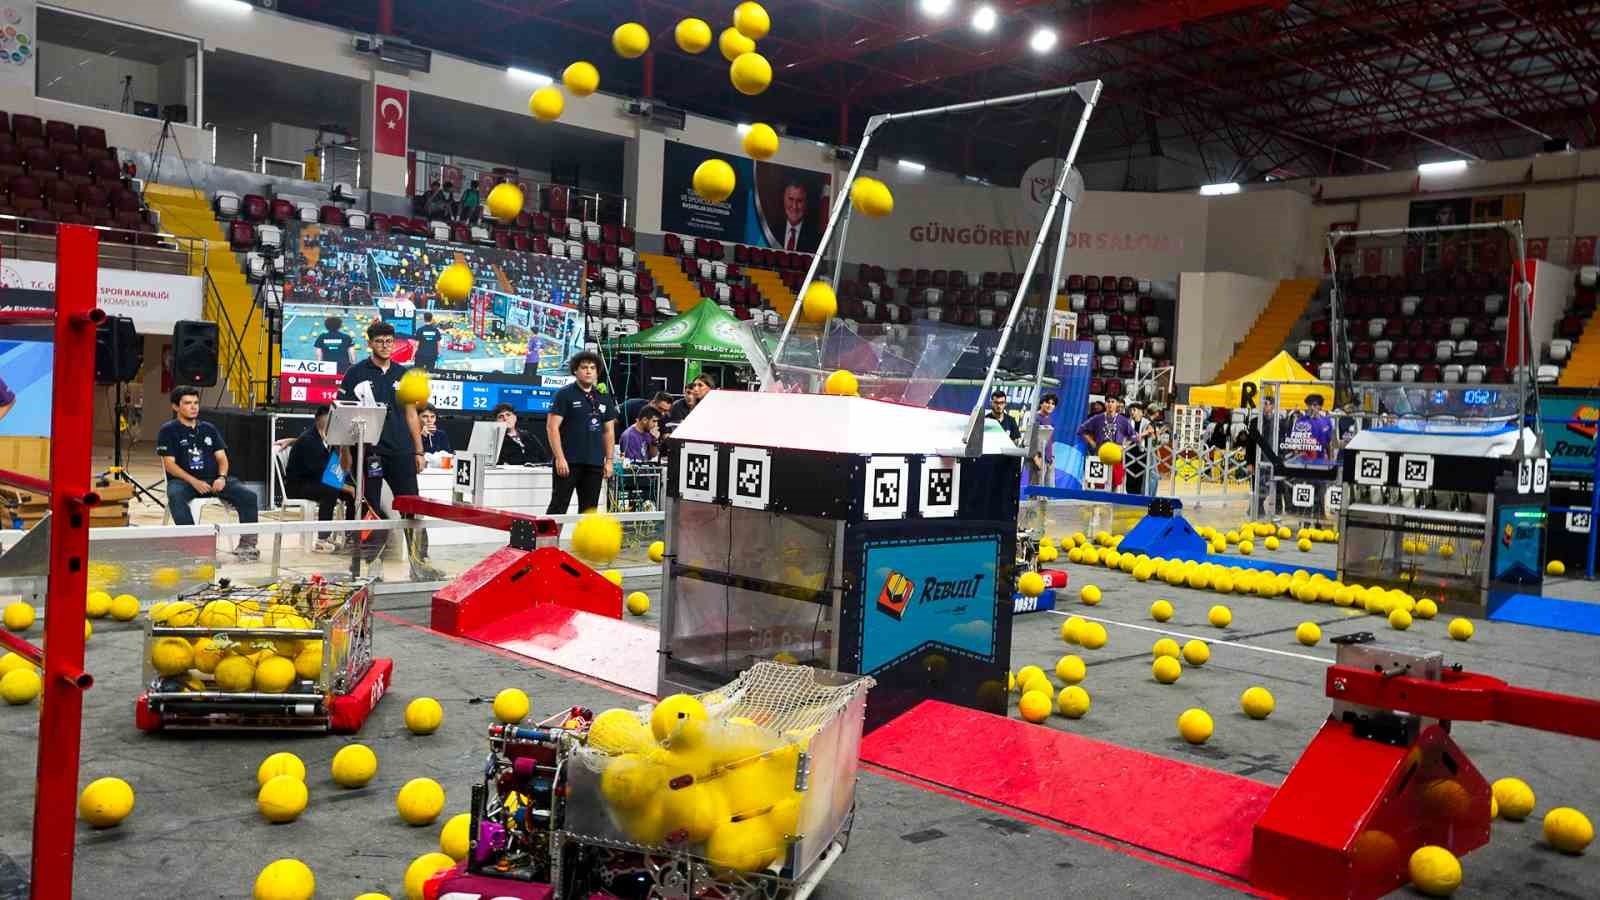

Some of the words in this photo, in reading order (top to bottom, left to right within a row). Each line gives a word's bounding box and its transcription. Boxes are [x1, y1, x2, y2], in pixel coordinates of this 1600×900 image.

[909, 222, 1030, 248] GÜNGÖREN
[100, 287, 123, 296] SPOR
[124, 288, 169, 299] BAKANLIĞI
[473, 397, 488, 408] 32
[1241, 381, 1257, 408] R
[1291, 432, 1312, 440] FIRST
[1280, 442, 1322, 452] COMPETITION
[1552, 440, 1594, 457] REBU
[920, 574, 984, 604] REBUILT
[1014, 596, 1038, 612] 10521
